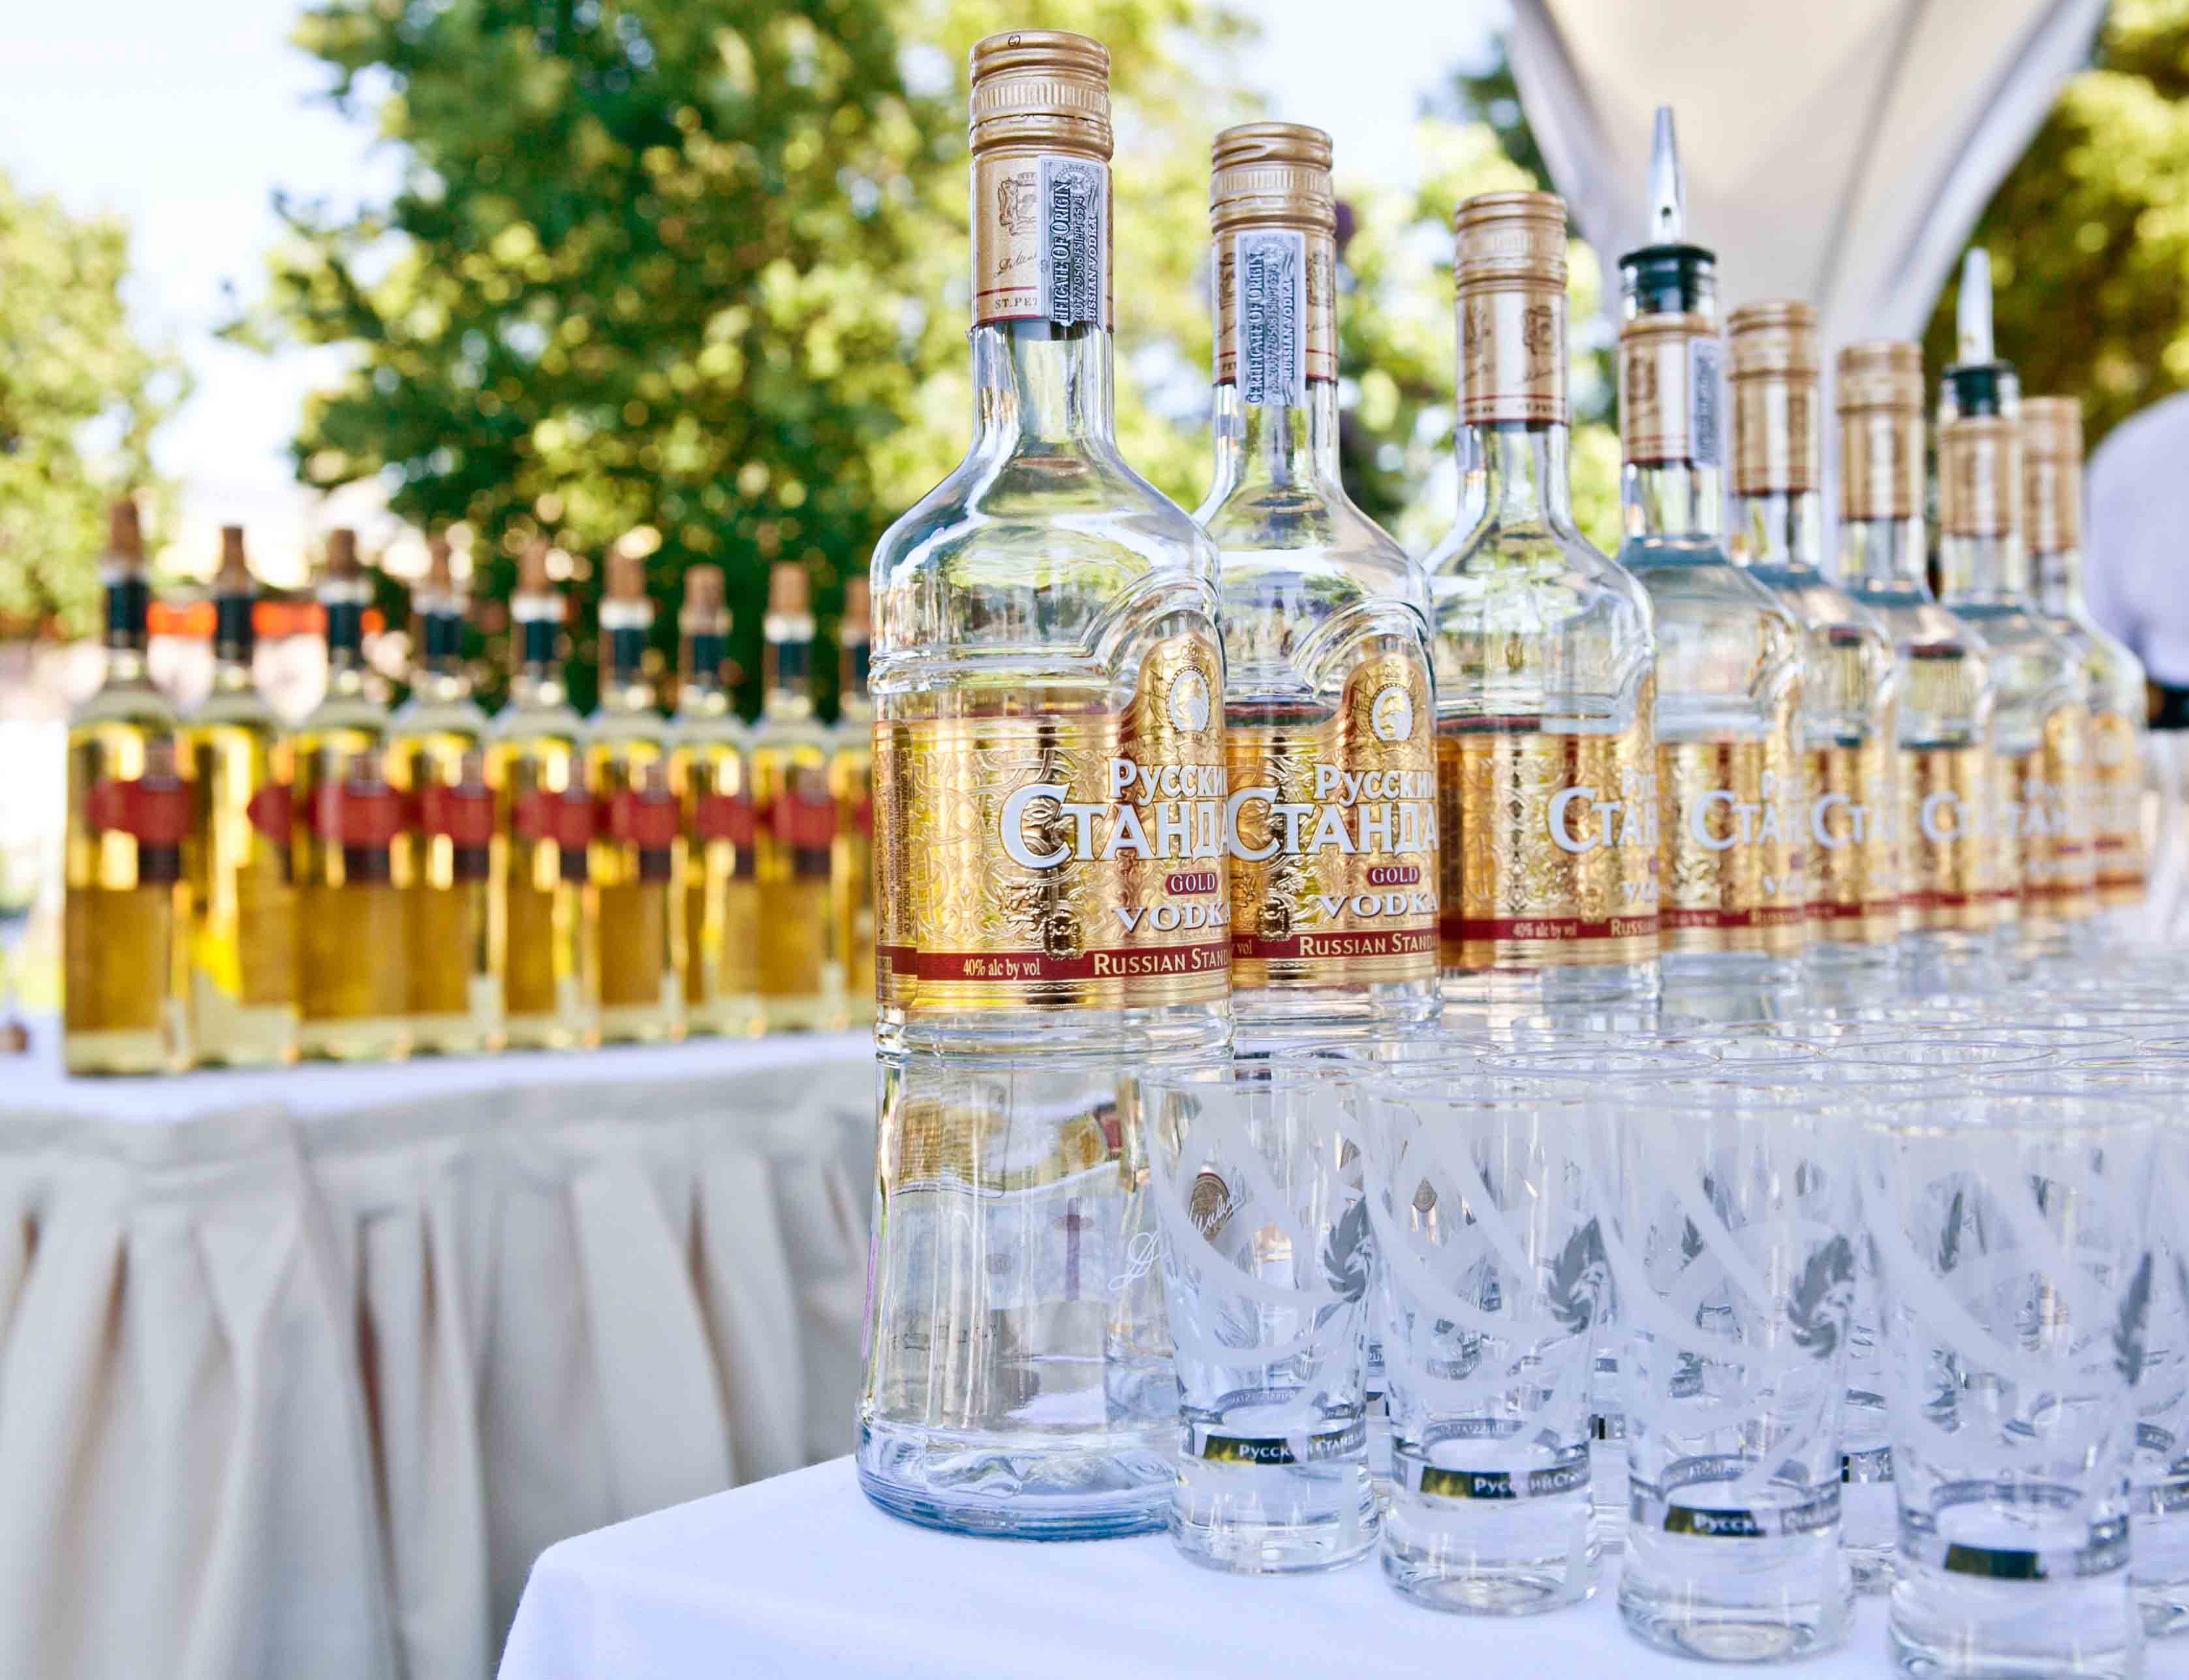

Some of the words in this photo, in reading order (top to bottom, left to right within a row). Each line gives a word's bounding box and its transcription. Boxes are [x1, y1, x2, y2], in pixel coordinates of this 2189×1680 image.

[1170, 873, 1216, 892] GOLD
[1371, 867, 1419, 883] GOLD
[963, 958, 986, 976] 40%
[988, 958, 1003, 976] alc
[1006, 958, 1020, 980] by
[1023, 957, 1041, 976] vol
